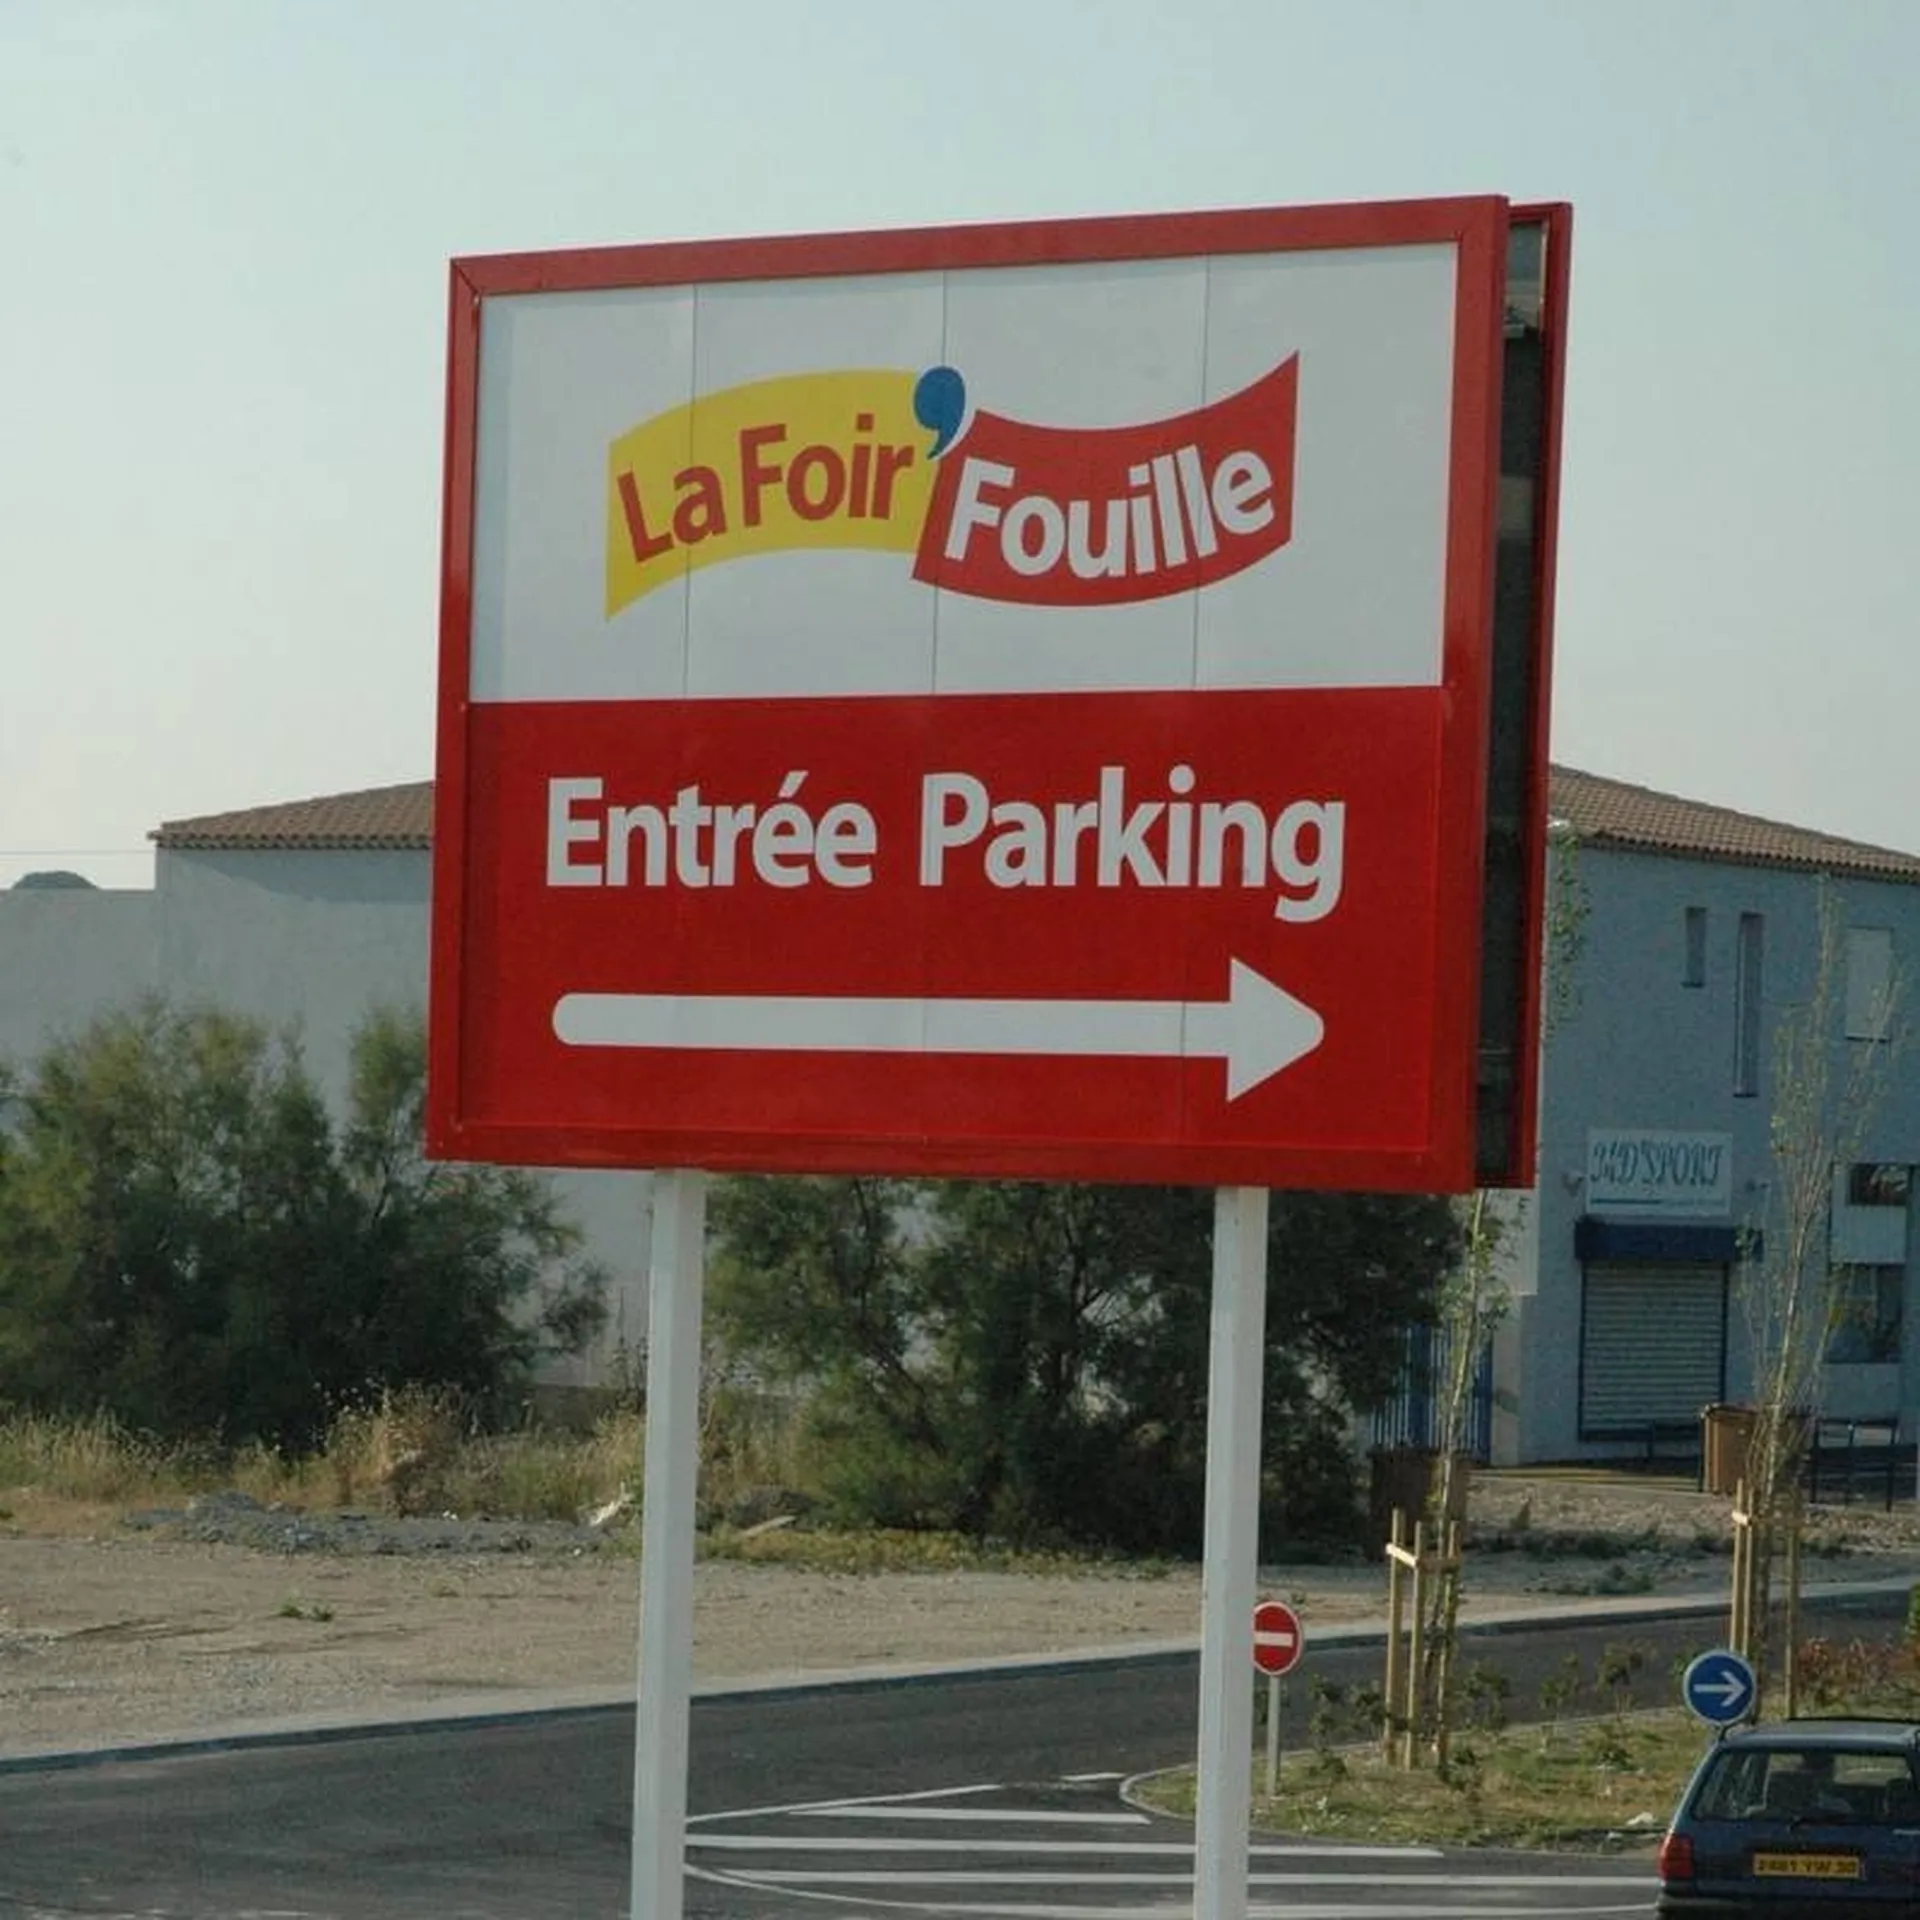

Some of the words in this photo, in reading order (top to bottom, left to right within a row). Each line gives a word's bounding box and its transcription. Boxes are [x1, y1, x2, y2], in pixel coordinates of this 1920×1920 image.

[616, 462, 727, 563] La
[944, 444, 1275, 580] Fouille
[546, 770, 877, 888] Entrée
[919, 766, 1346, 923] Parking
